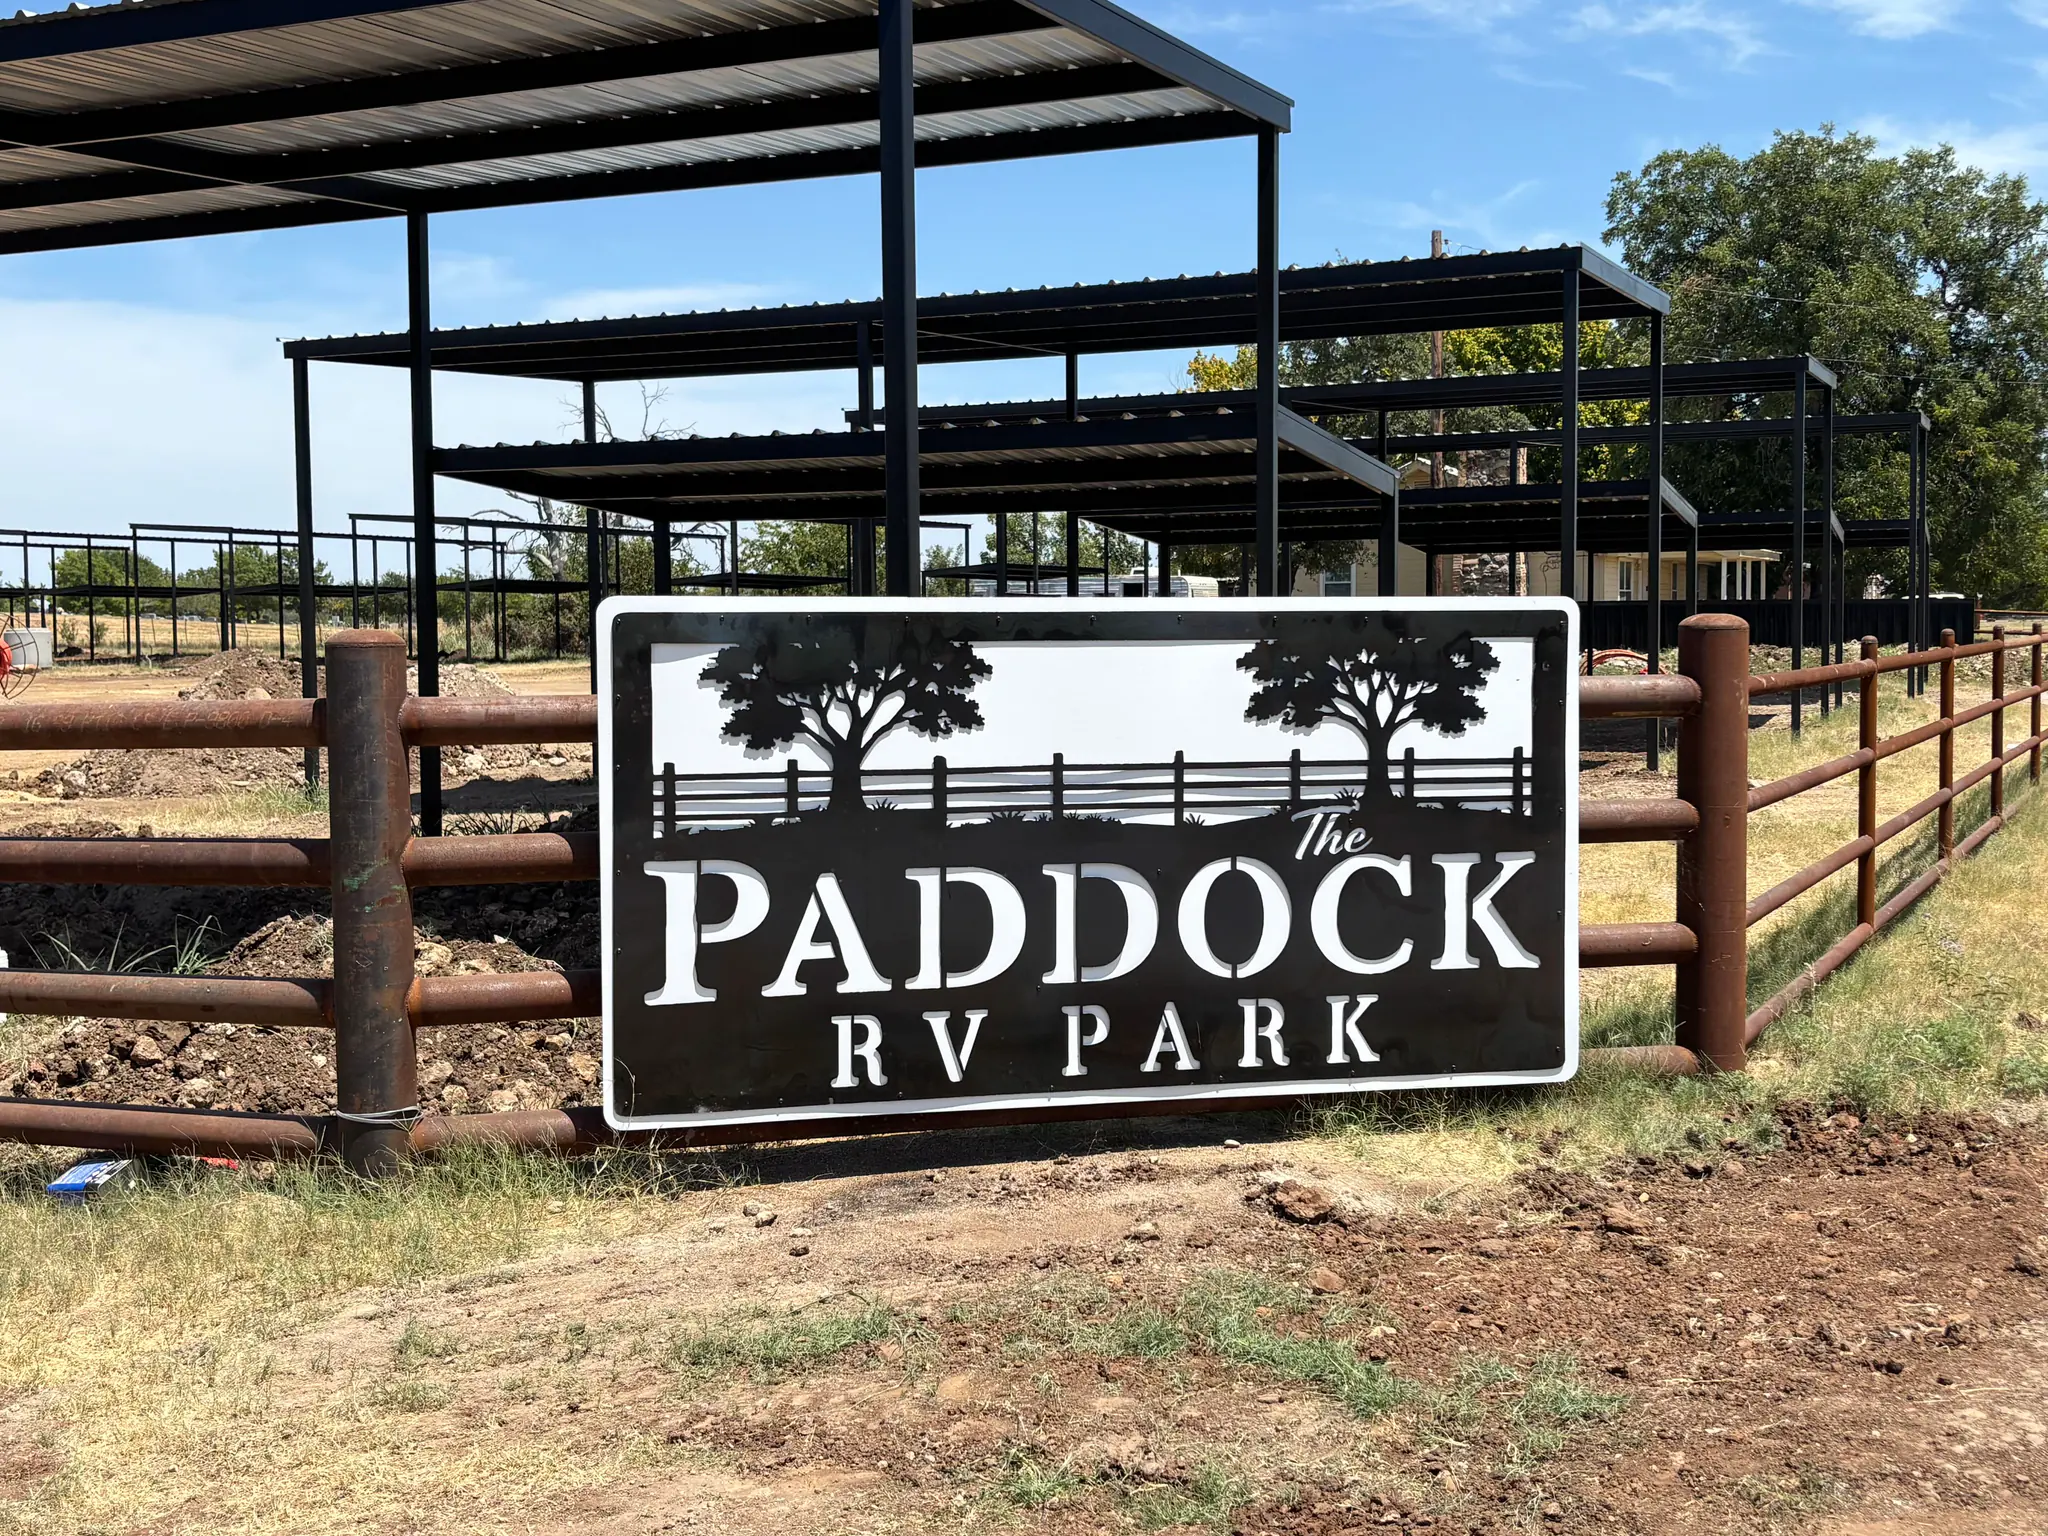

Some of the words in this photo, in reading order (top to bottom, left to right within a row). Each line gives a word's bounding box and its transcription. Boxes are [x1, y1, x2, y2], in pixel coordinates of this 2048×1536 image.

[1291, 802, 1374, 860] The
[643, 851, 1541, 1007] PADDOCK
[830, 1010, 989, 1088] RV
[1061, 995, 1381, 1077] PARK
